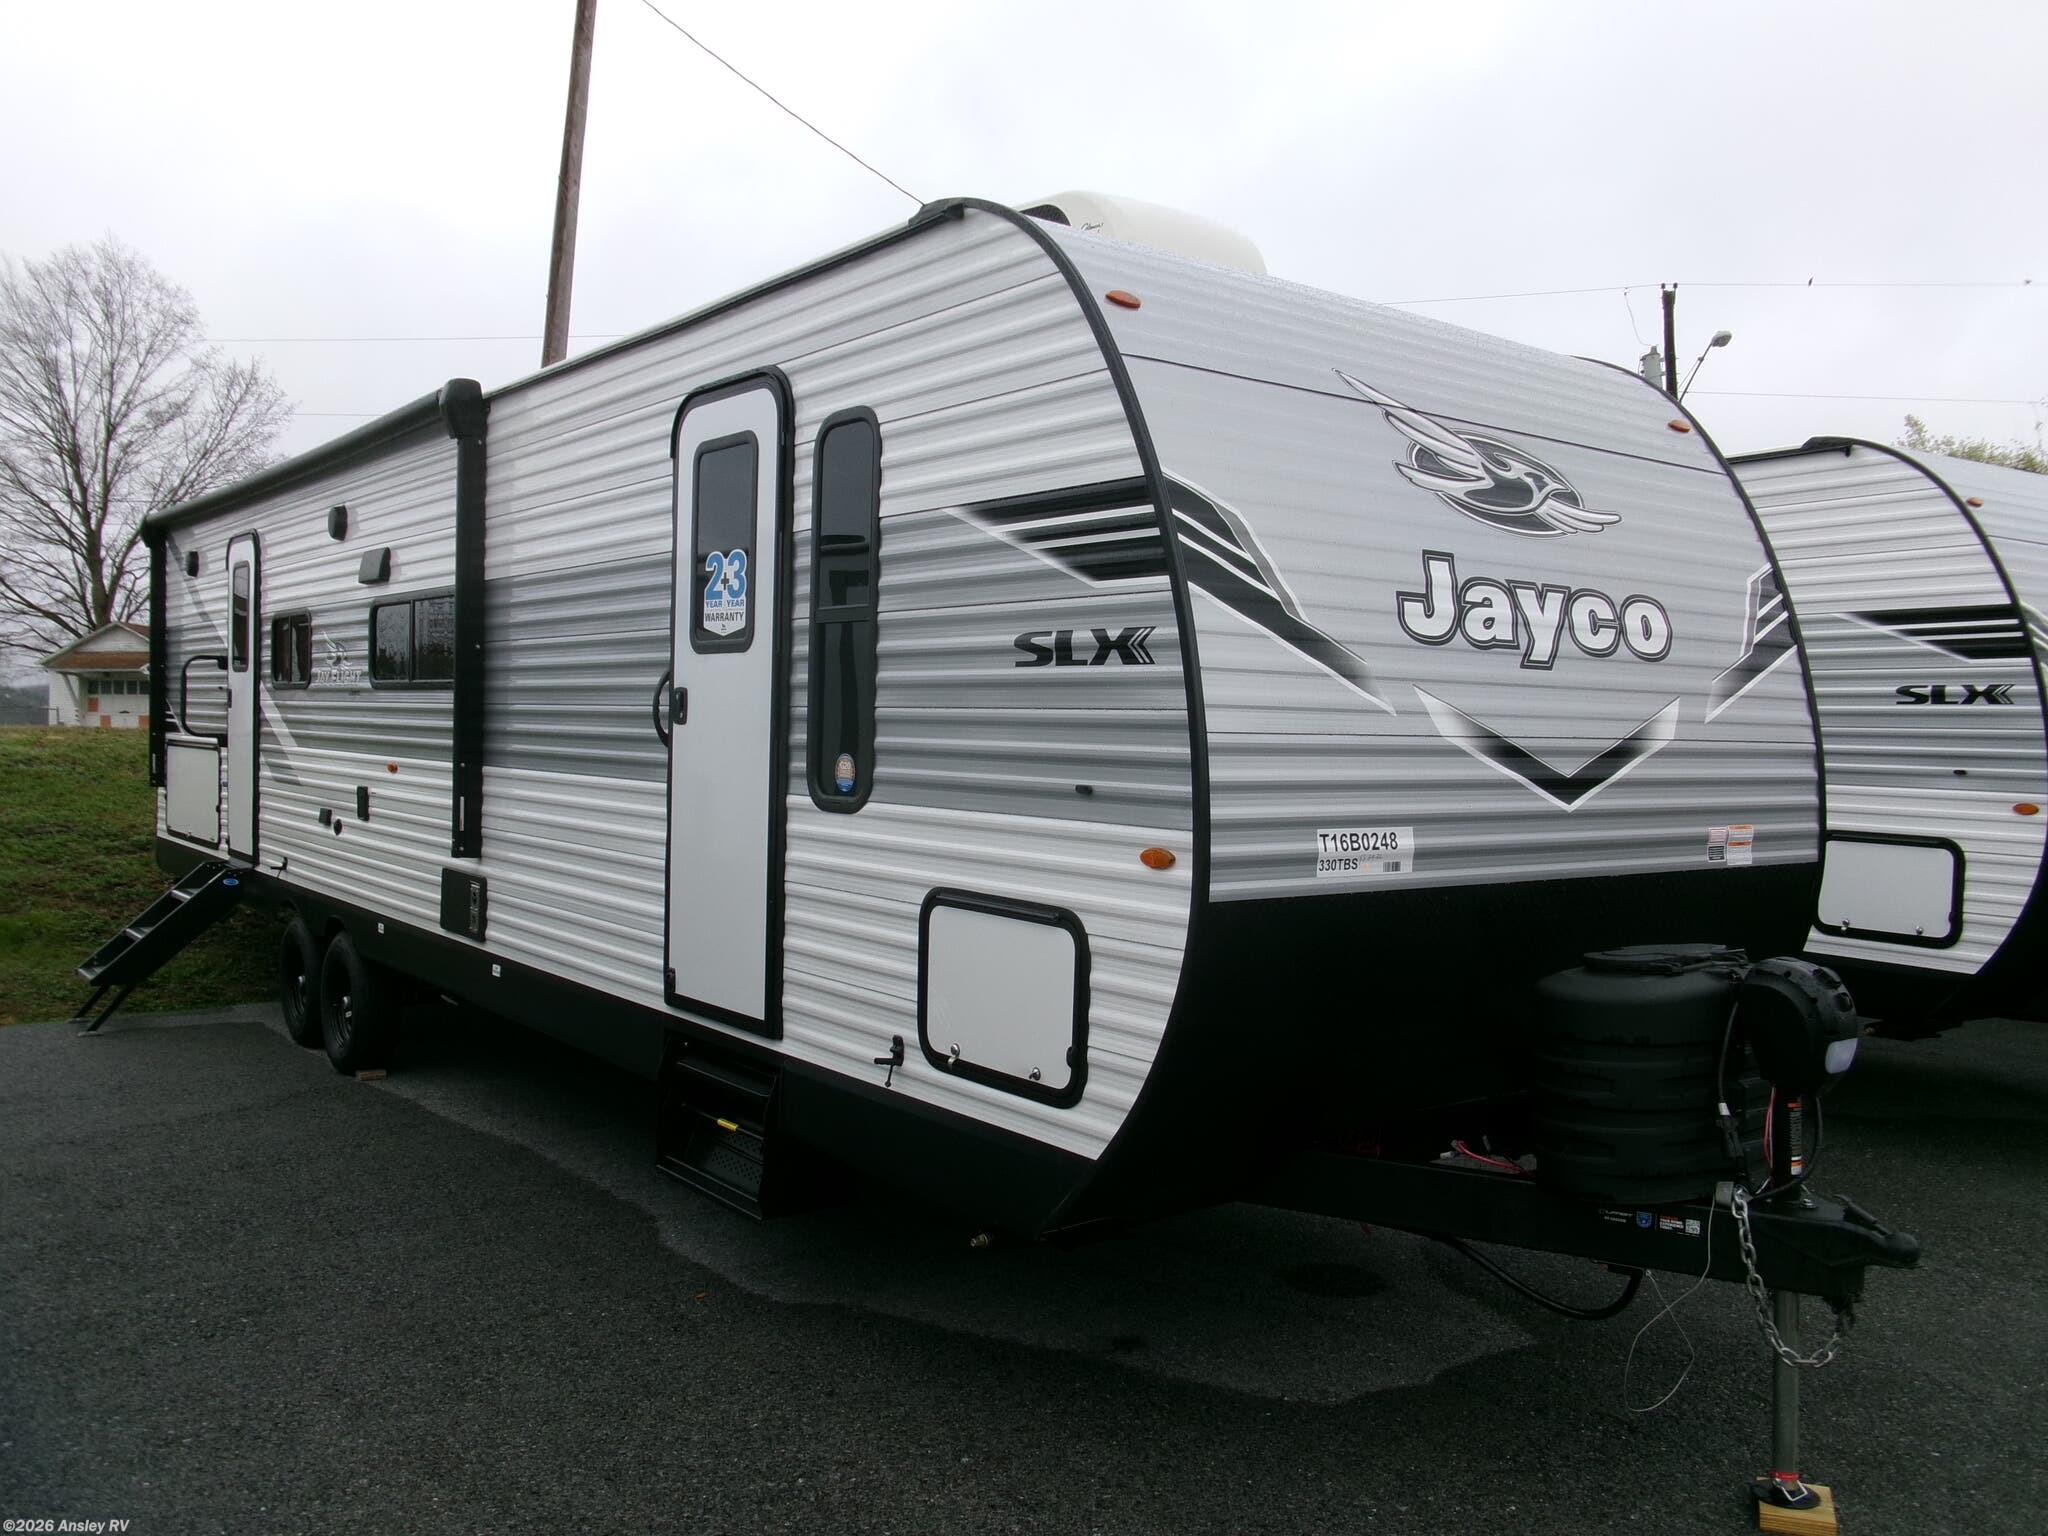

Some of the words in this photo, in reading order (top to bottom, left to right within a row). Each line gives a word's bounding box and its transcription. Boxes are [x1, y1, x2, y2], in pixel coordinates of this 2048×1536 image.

[706, 600, 723, 608] YEAR
[727, 600, 745, 608] YEAR
[1396, 549, 1672, 671] Jayco
[705, 611, 745, 622] WARRANTY
[1014, 626, 1157, 667] SLX
[1896, 684, 2016, 705] SLX
[1319, 832, 1398, 852] T16B0248
[1319, 858, 1358, 872] 330TBS
